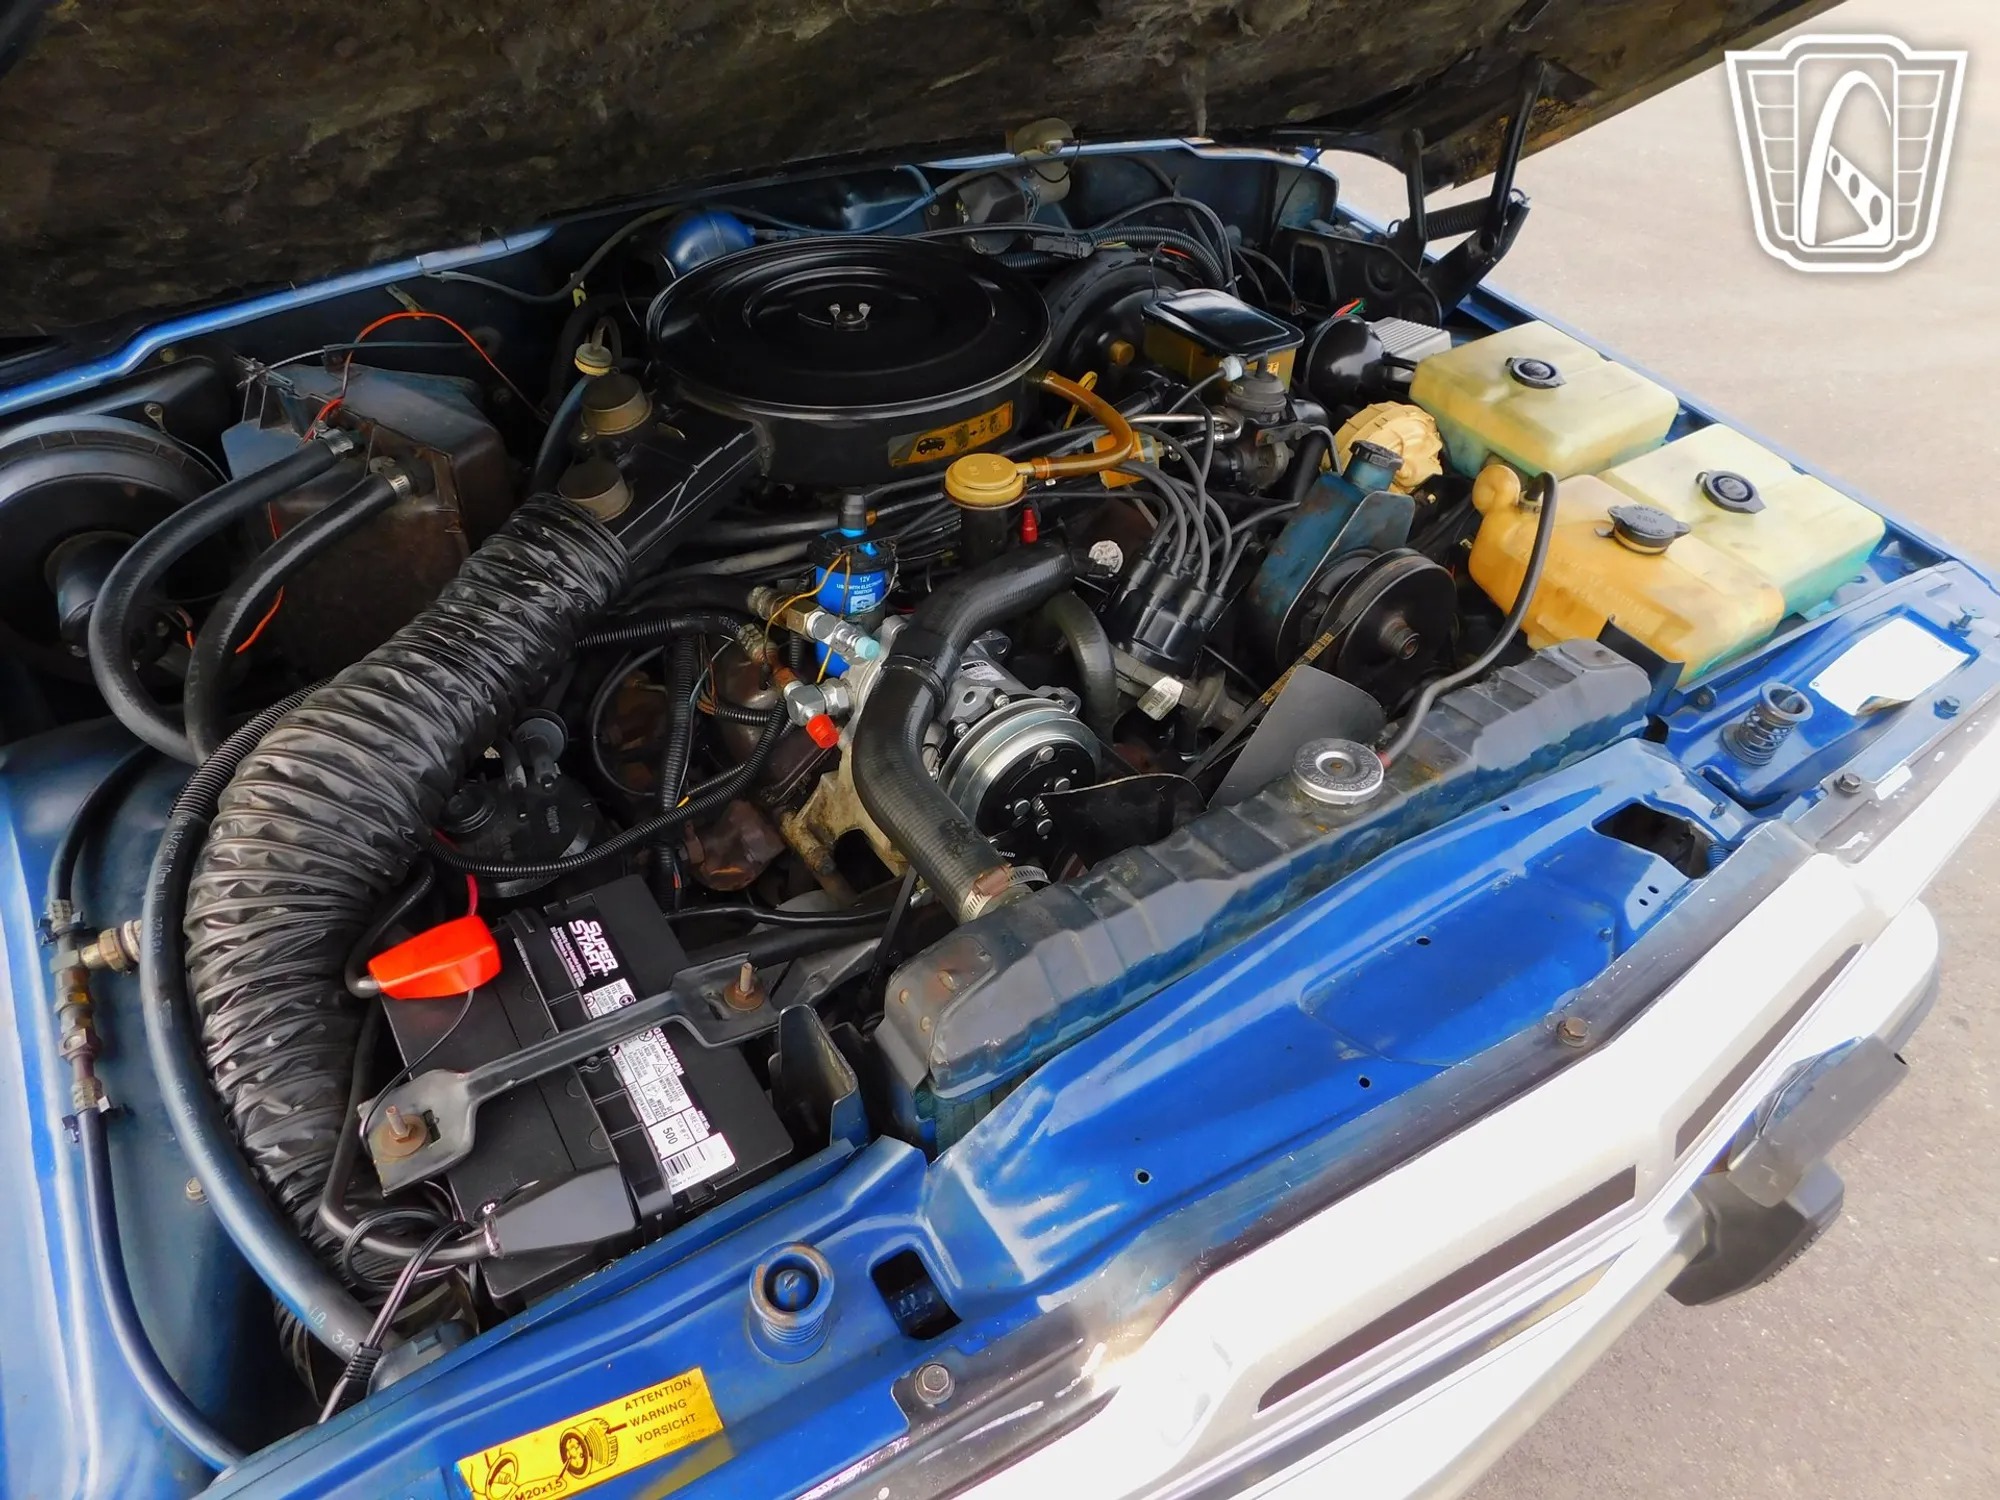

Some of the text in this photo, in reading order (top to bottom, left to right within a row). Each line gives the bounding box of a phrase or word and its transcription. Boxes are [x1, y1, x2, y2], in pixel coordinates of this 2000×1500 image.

[860, 575, 871, 583] 12V
[568, 920, 607, 973] START
[584, 921, 619, 970] SUPER
[662, 1126, 678, 1145] 500
[624, 1377, 692, 1412] ATTENTION
[629, 1399, 687, 1428] WARNING
[635, 1413, 697, 1444] VORSICHT
